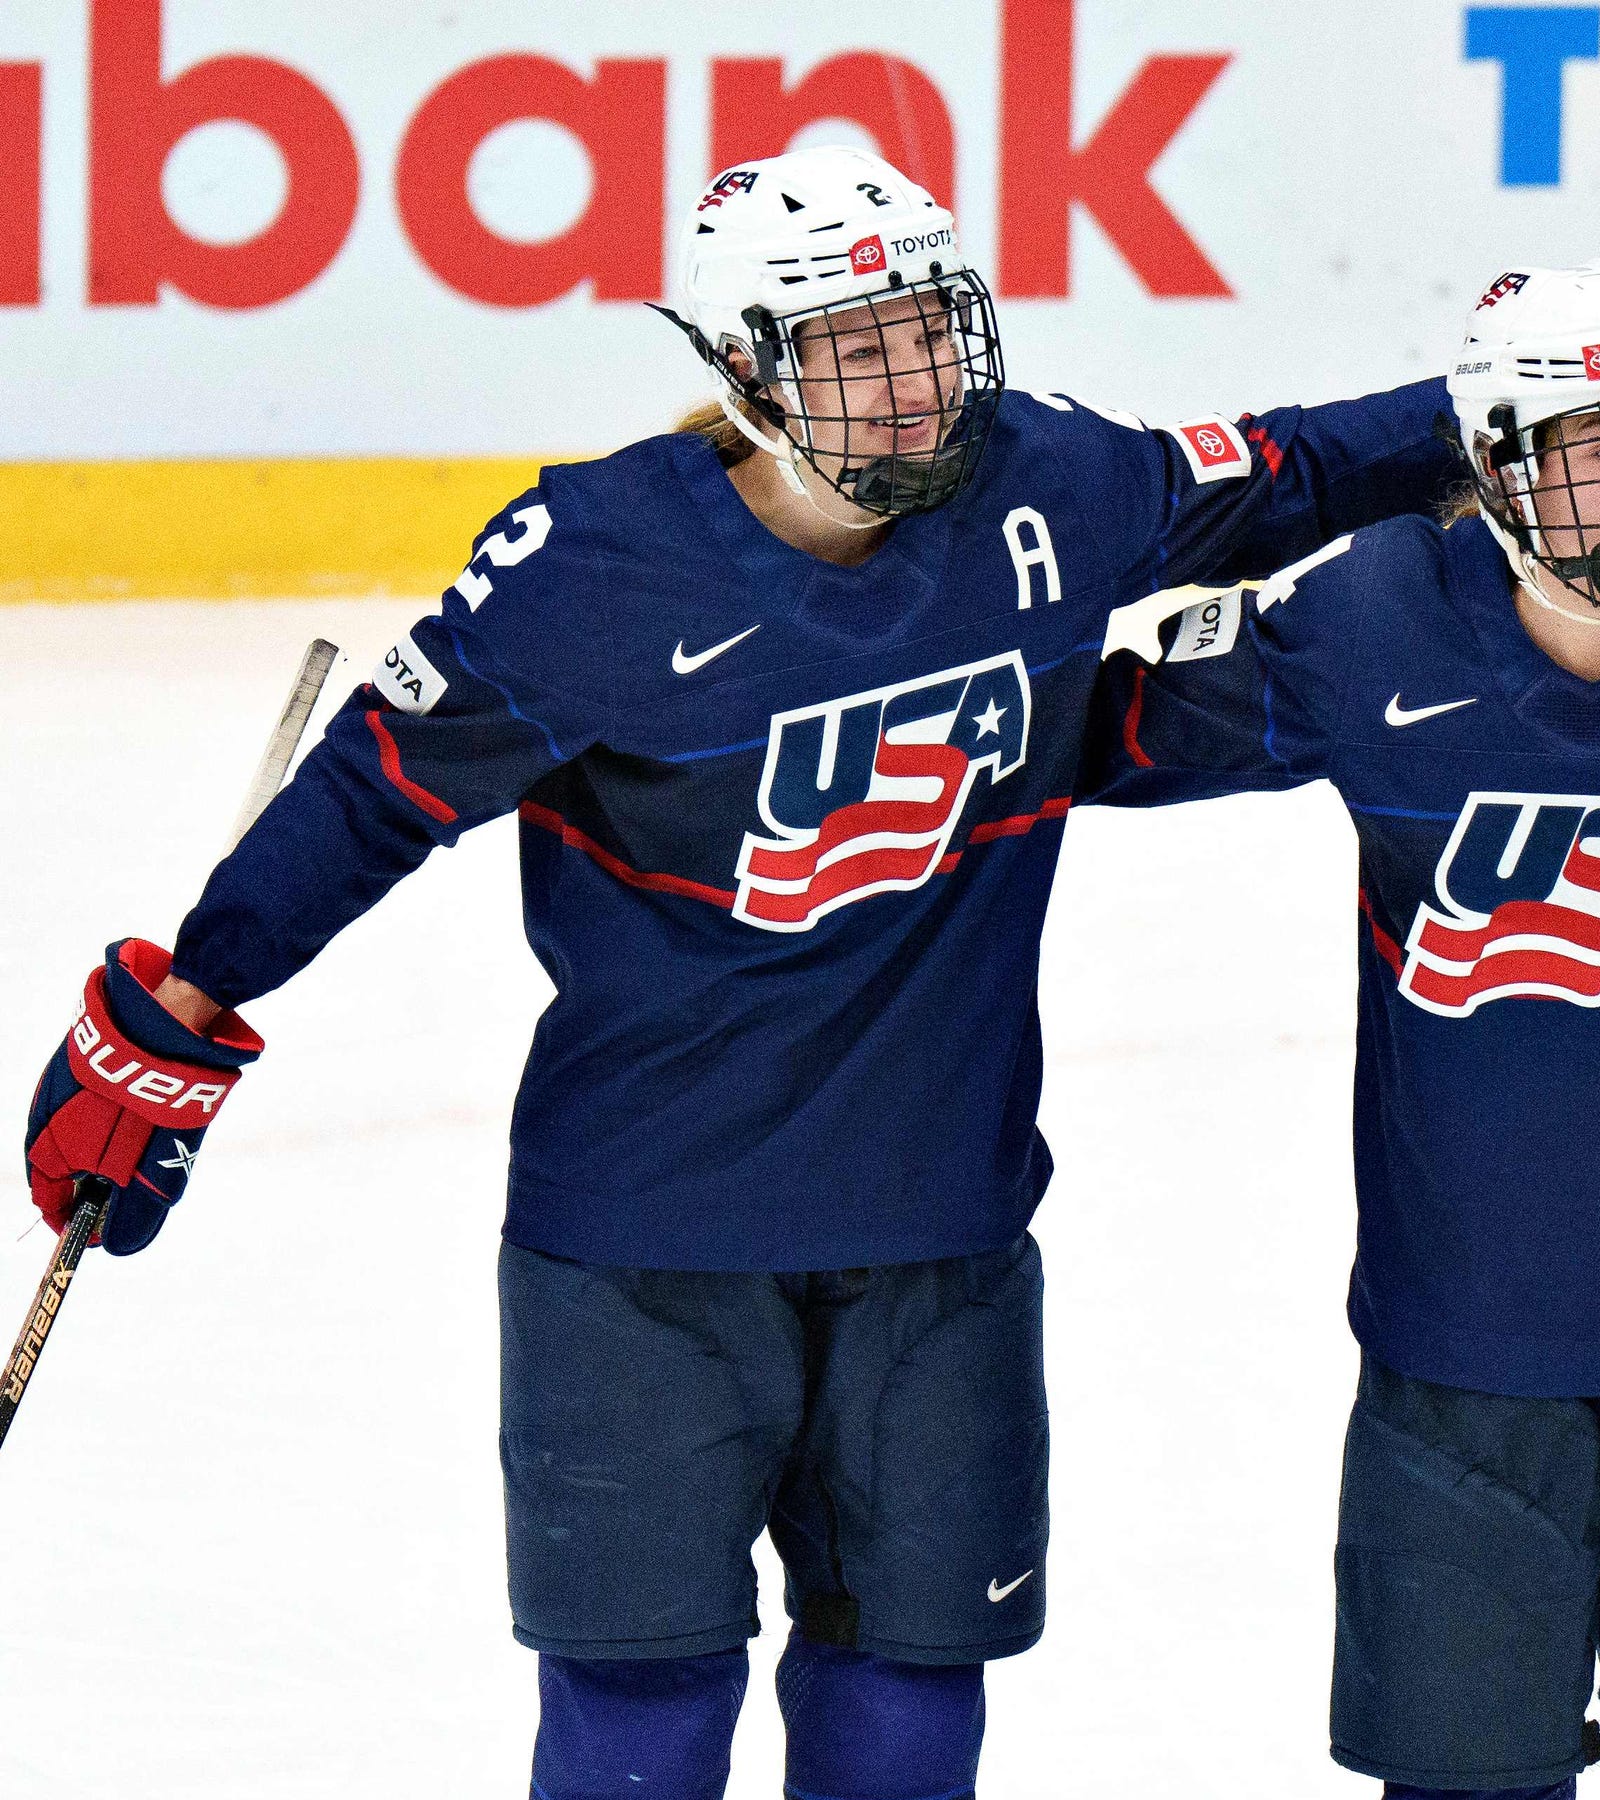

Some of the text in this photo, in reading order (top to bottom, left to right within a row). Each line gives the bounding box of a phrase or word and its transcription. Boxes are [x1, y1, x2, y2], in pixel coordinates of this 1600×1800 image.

[0, 0, 1237, 309] bank
[856, 183, 893, 207] 2
[454, 504, 553, 613] 2
[1002, 505, 1062, 610] A
[731, 649, 1032, 933] USA
